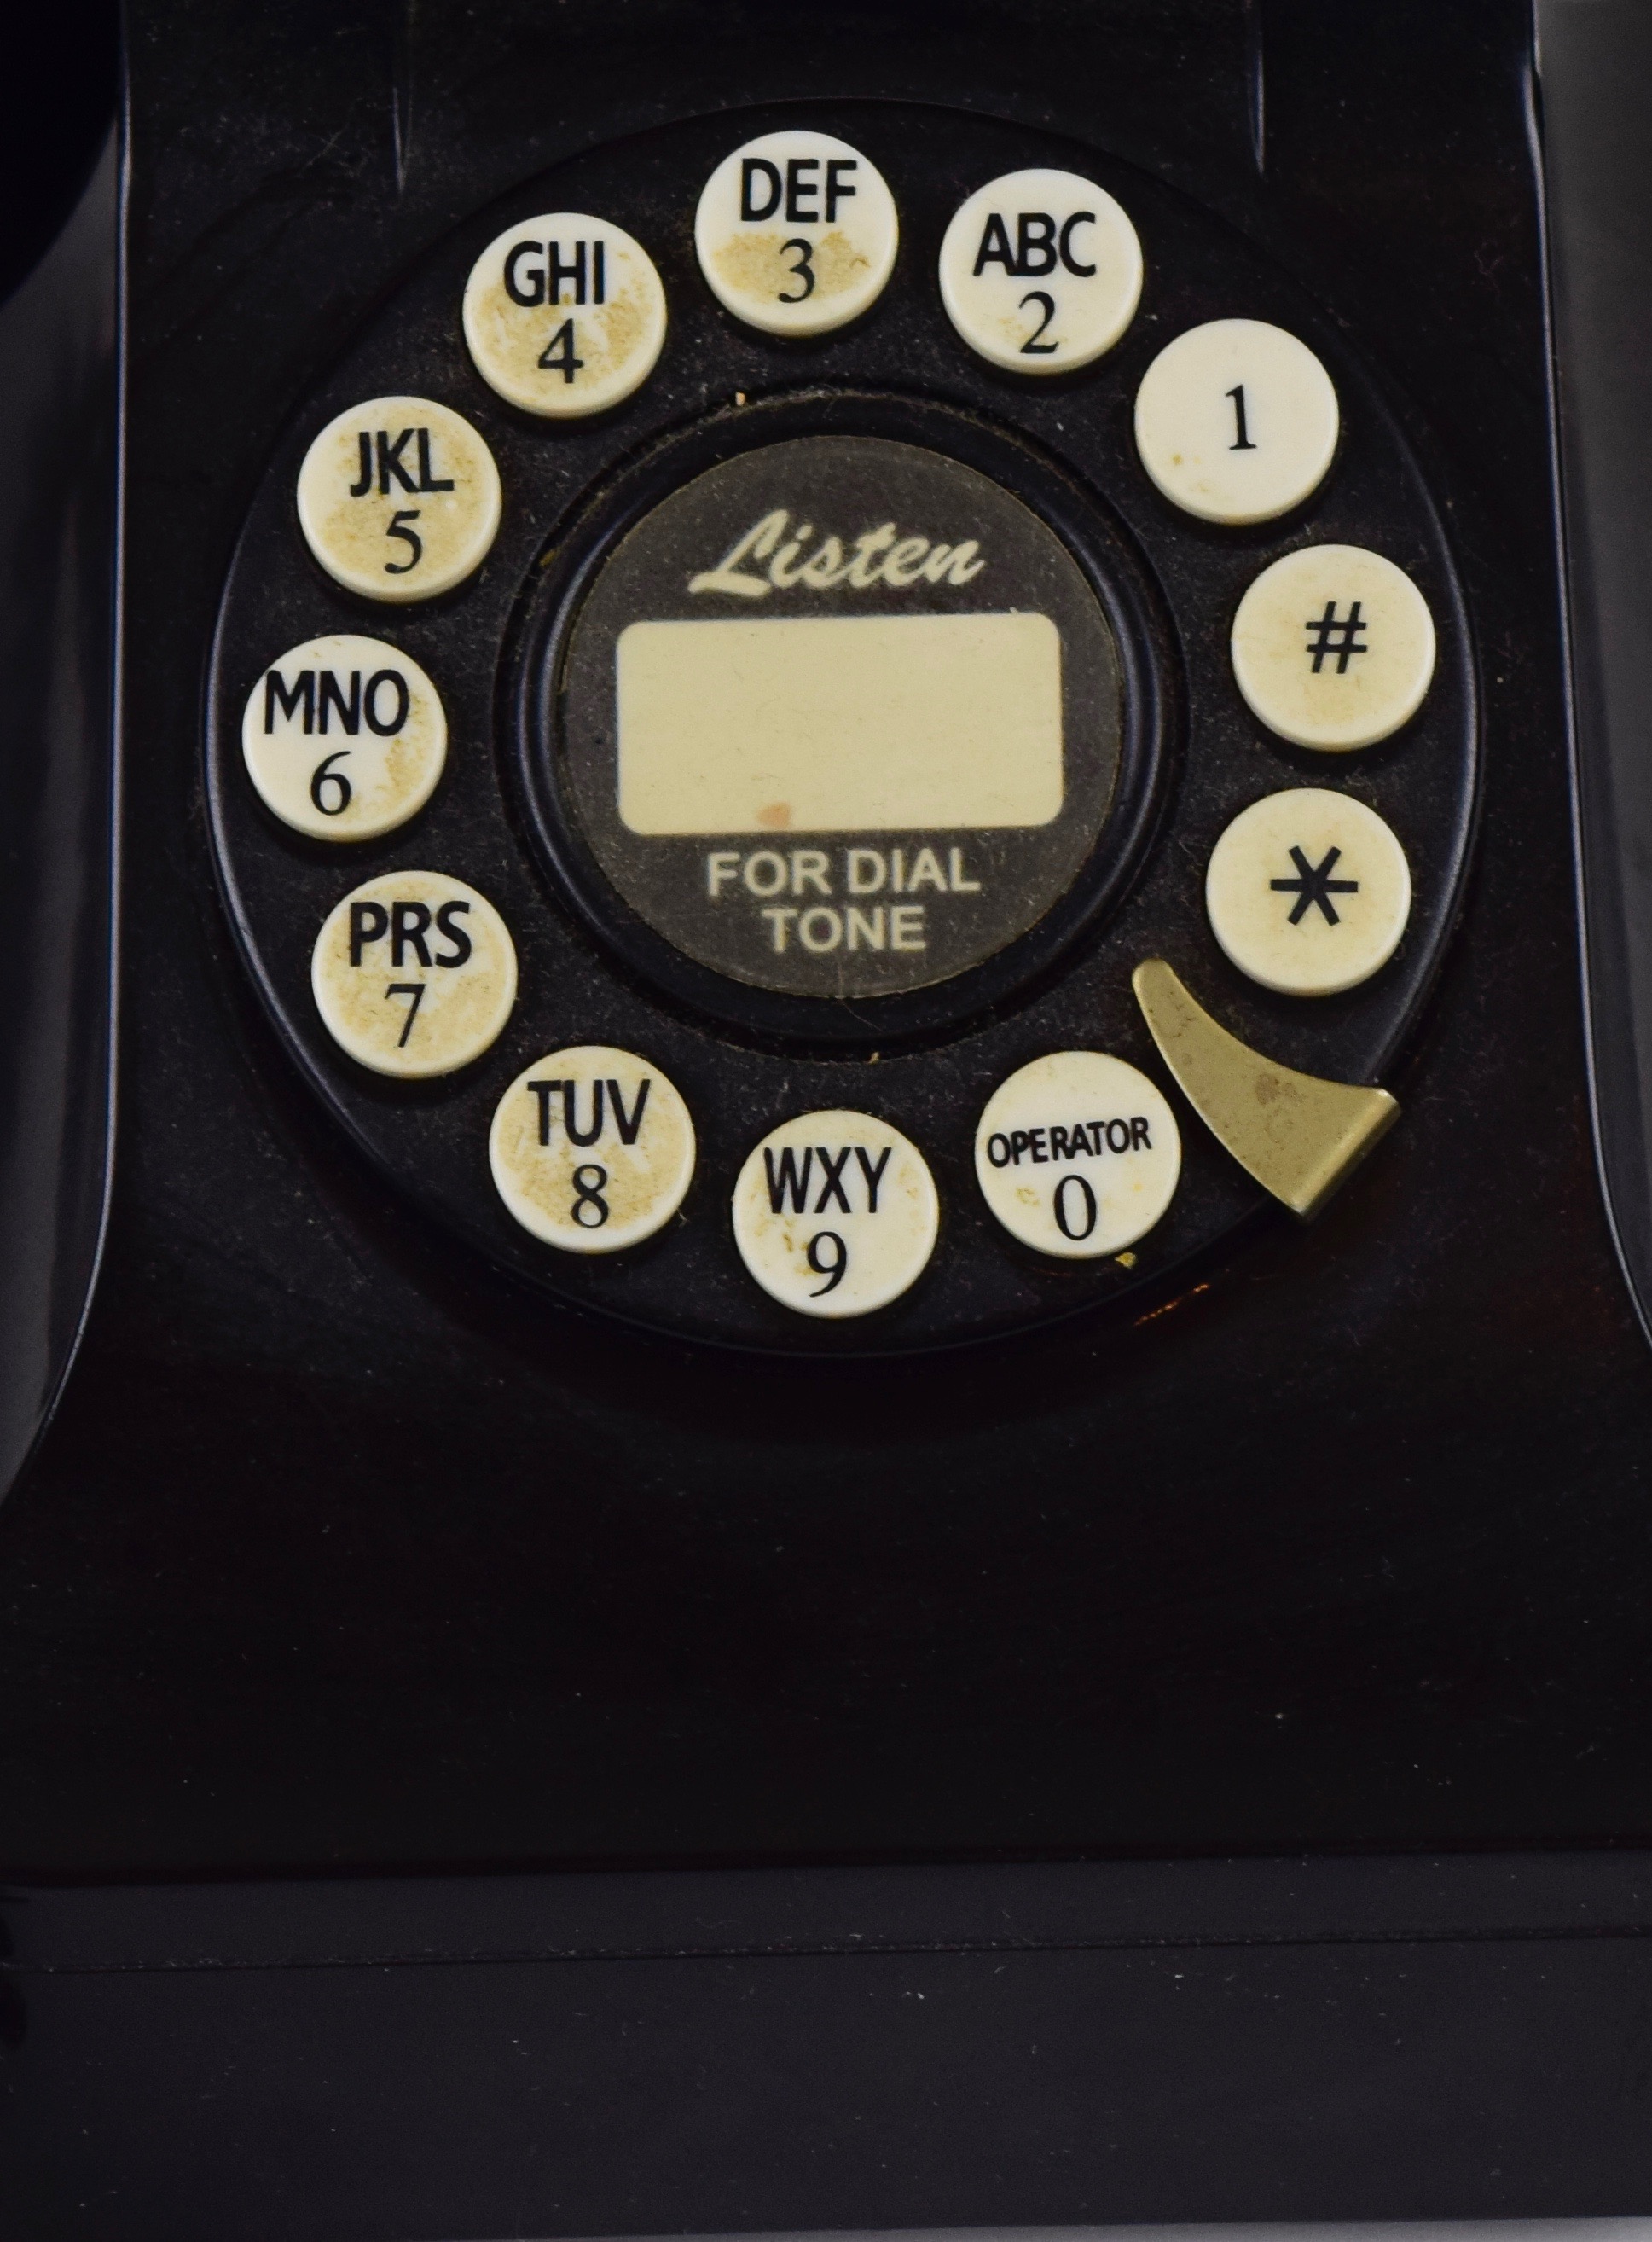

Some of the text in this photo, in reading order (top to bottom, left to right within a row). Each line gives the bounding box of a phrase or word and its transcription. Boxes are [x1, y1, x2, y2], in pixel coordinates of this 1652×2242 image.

[740, 157, 858, 224] DEF
[503, 240, 605, 308] GHI
[778, 238, 816, 304] 3
[972, 211, 1097, 278] ABC
[537, 317, 585, 385] 4
[1018, 290, 1059, 355] 2
[1226, 384, 1257, 450] 1
[350, 427, 455, 498] JKL
[385, 509, 423, 575] 5
[687, 508, 986, 599] Listen
[1305, 601, 1368, 675] #
[264, 670, 410, 736] MNO
[310, 751, 352, 816] 6
[707, 847, 981, 897] FOR DIAL
[348, 900, 472, 969] PRS
[761, 905, 927, 953] TONE
[384, 983, 426, 1048] 7
[526, 1078, 652, 1147] TUV
[987, 1116, 1152, 1169] OPERATOR
[570, 1164, 610, 1229] 8
[762, 1146, 892, 1215] WXY
[1052, 1174, 1098, 1241] 0
[805, 1231, 848, 1298] 9
